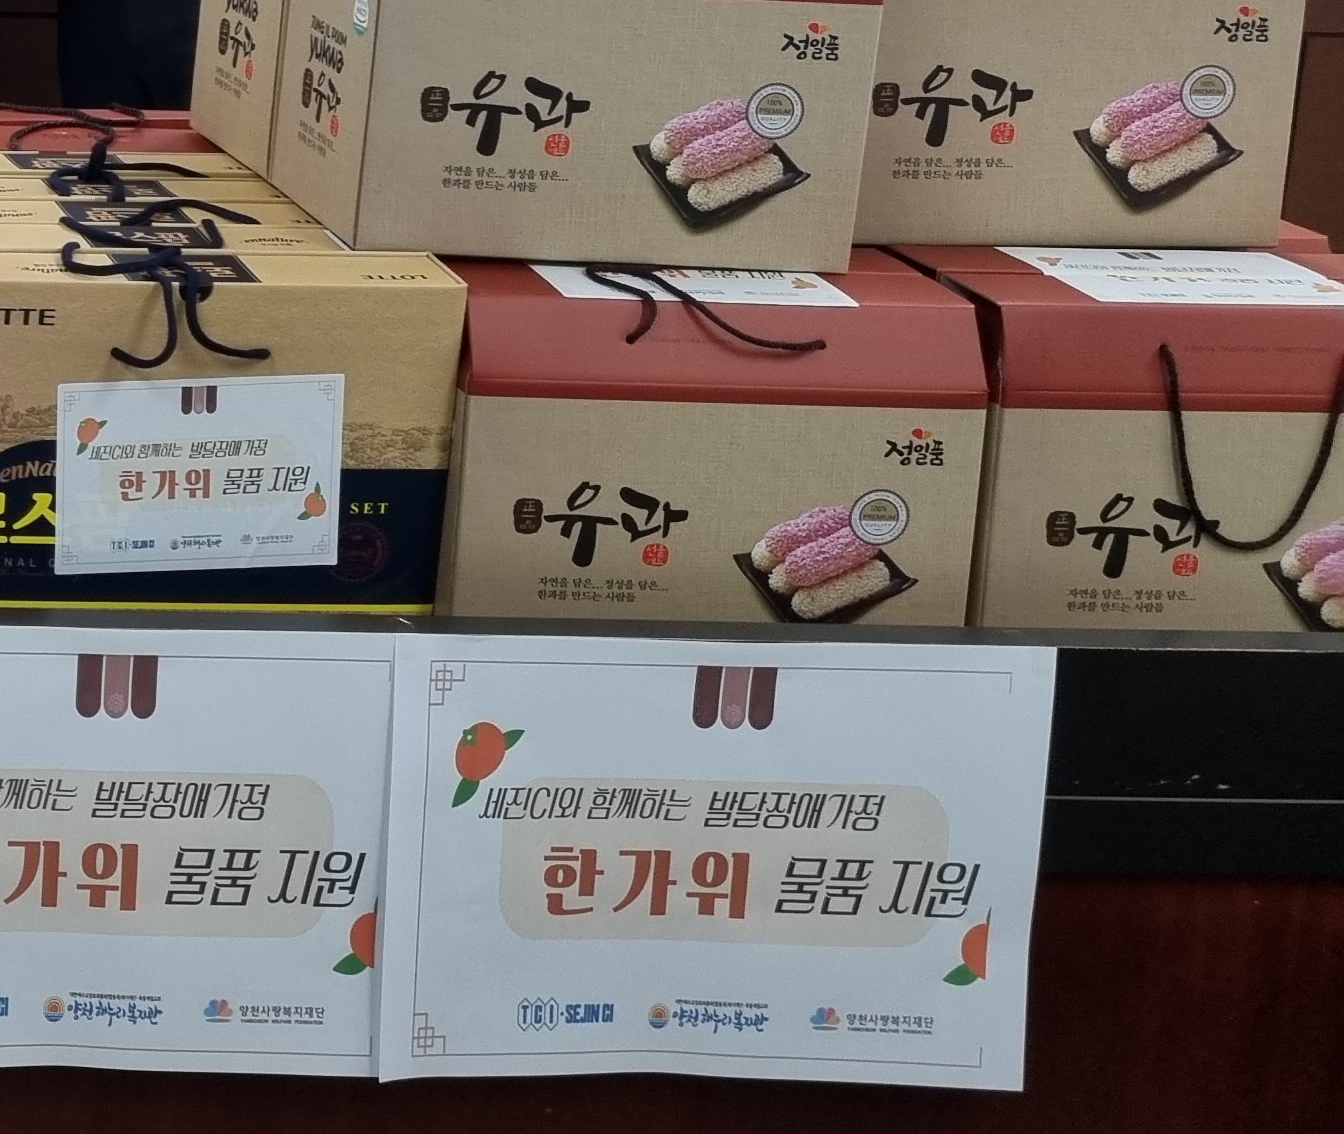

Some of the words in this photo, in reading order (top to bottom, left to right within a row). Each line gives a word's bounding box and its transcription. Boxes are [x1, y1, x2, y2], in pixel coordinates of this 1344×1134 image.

[779, 30, 840, 63] 정일품
[1213, 16, 1270, 44] 정일품
[450, 70, 592, 157] 유과
[899, 64, 1034, 148] 유과
[137, 443, 184, 459] 함께하는
[188, 438, 269, 460] 발달장애가정
[883, 439, 945, 468] 정일품
[118, 468, 212, 503] 한가위
[221, 466, 265, 496] 물품
[267, 465, 312, 493] 지원
[349, 500, 390, 515] SET
[543, 479, 690, 569] 유과
[89, 779, 271, 822] 발달장애가정
[477, 786, 582, 822] 세진CI와
[586, 786, 693, 823] 함께하는
[702, 789, 887, 832] 발달장애가정
[163, 845, 263, 907] 물품
[266, 849, 368, 910] 지원
[542, 844, 752, 920] 한가위
[772, 853, 875, 917] 물품
[878, 858, 981, 920] 지원
[845, 1011, 935, 1029] 양천사랑복지재단
